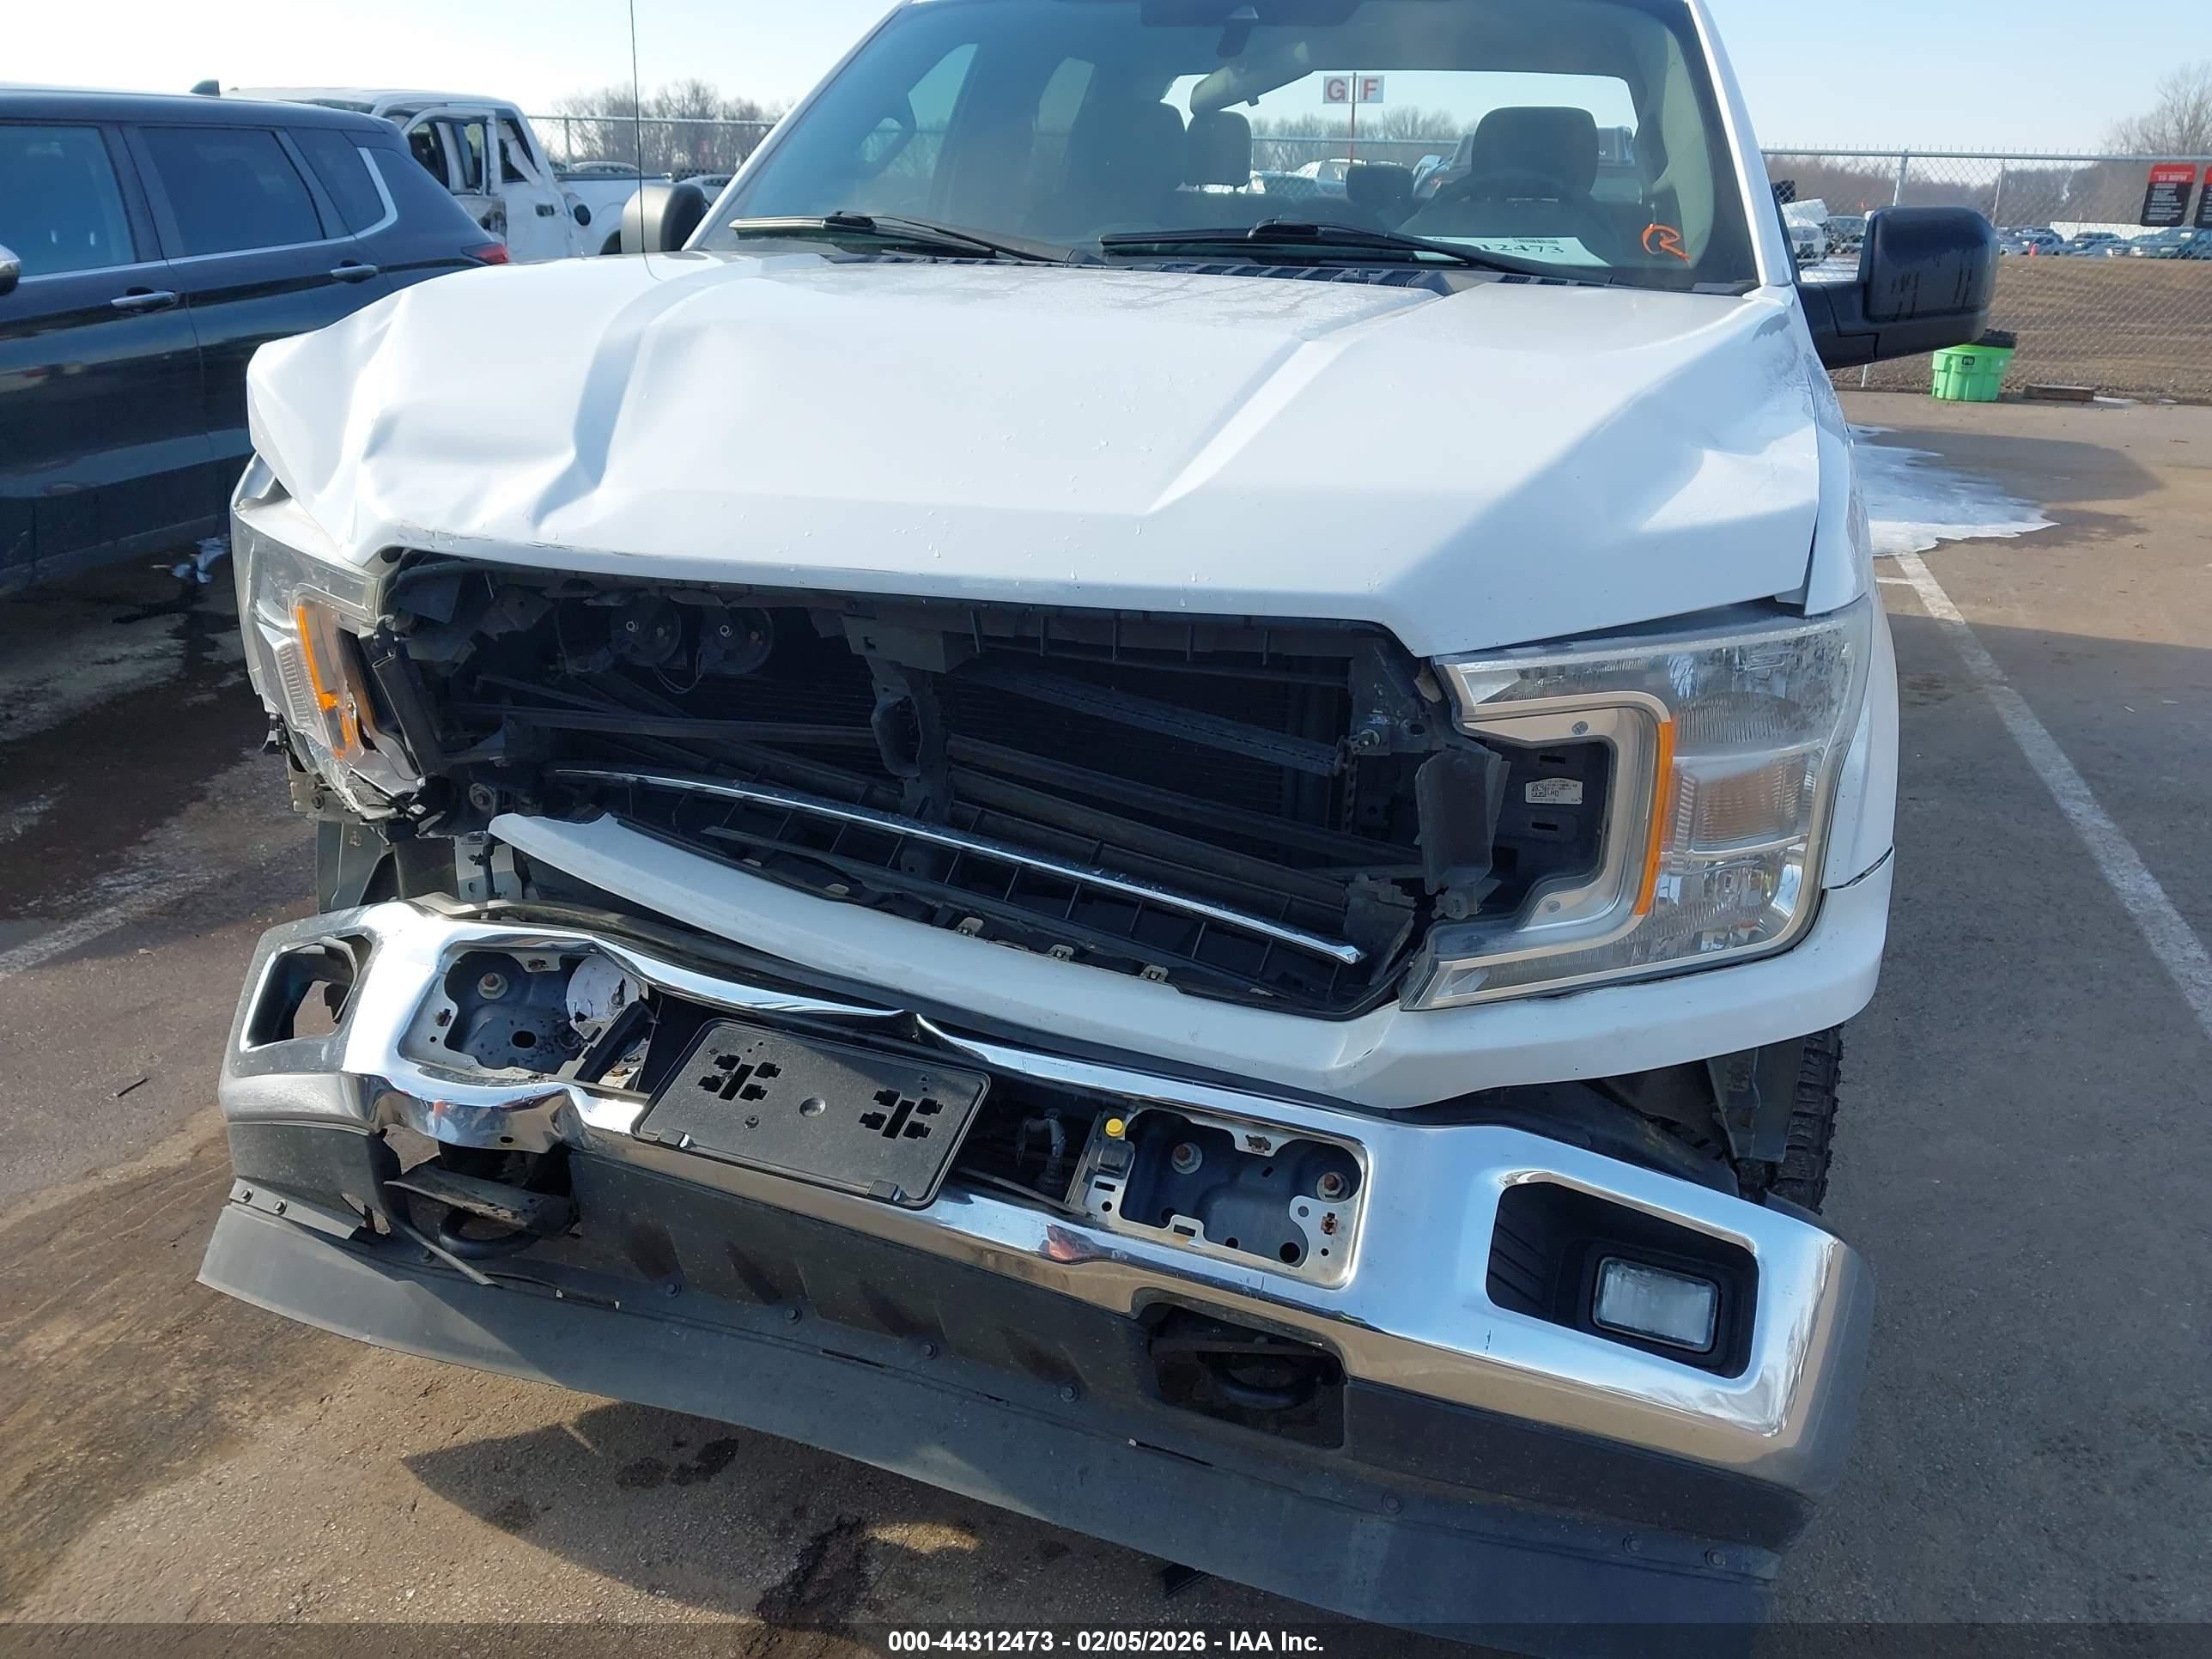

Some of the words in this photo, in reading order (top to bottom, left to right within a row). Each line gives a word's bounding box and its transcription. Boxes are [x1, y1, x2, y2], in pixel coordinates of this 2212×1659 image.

[1327, 78, 1346, 101] G
[1363, 78, 1378, 100] F
[1480, 243, 1565, 254] 12473
